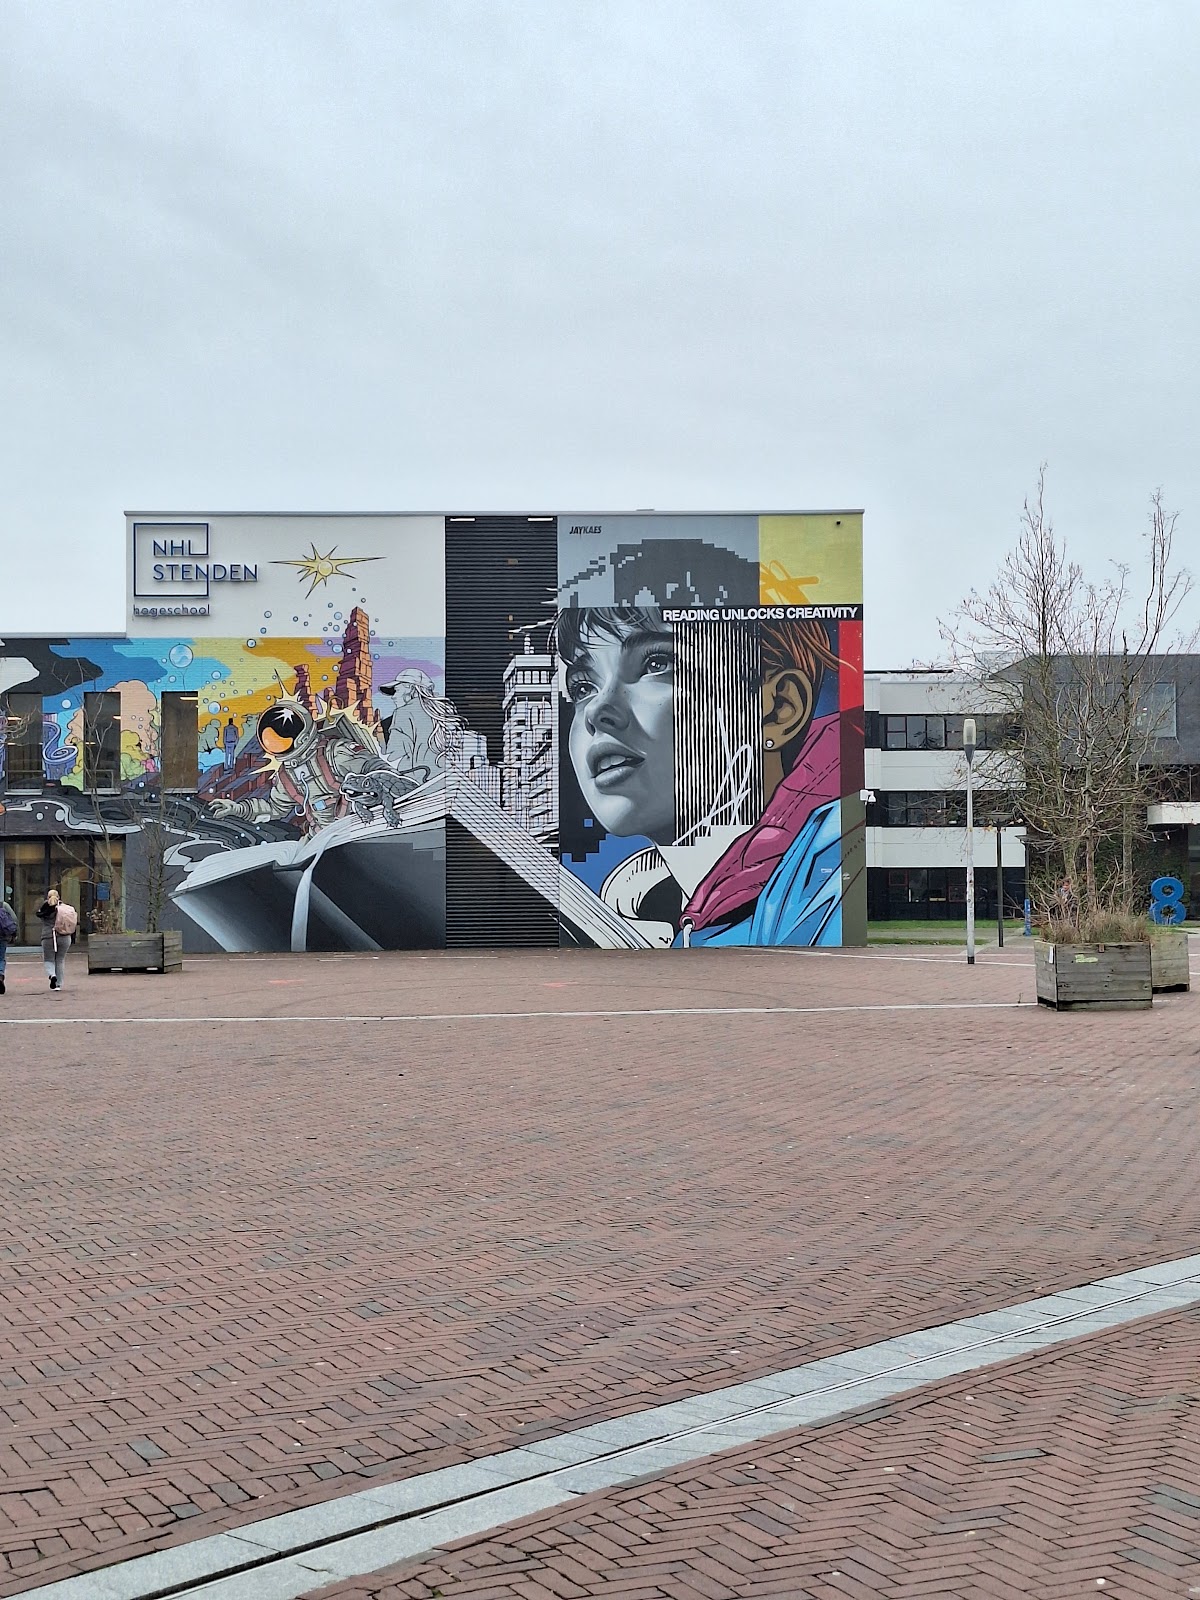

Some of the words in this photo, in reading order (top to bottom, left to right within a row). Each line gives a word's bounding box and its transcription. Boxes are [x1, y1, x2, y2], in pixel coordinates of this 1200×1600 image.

[569, 525, 602, 535] JAYKAES
[152, 539, 209, 556] NHL
[152, 563, 258, 581] STENDEN
[133, 603, 210, 617] hogeschool
[662, 609, 720, 622] READING
[722, 608, 785, 621] UNLOCKS
[786, 606, 858, 619] CREATIVITY
[1150, 876, 1186, 925] 8
